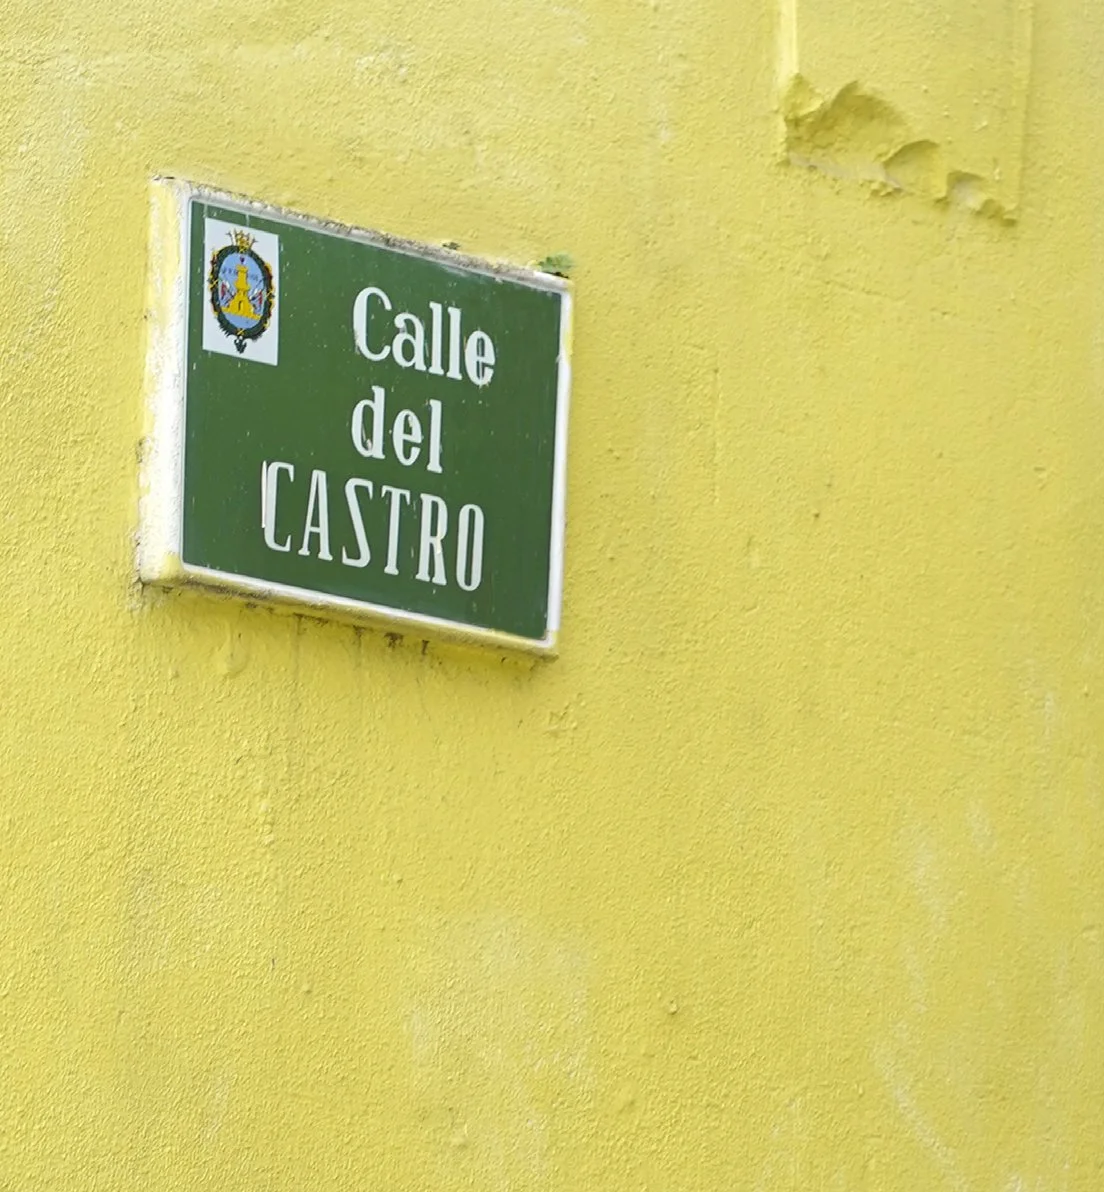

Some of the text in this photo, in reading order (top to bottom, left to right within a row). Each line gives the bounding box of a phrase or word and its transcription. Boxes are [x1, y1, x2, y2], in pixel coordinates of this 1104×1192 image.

[352, 286, 496, 386] Calle
[351, 385, 443, 474] del
[261, 460, 485, 592] CASTRO
